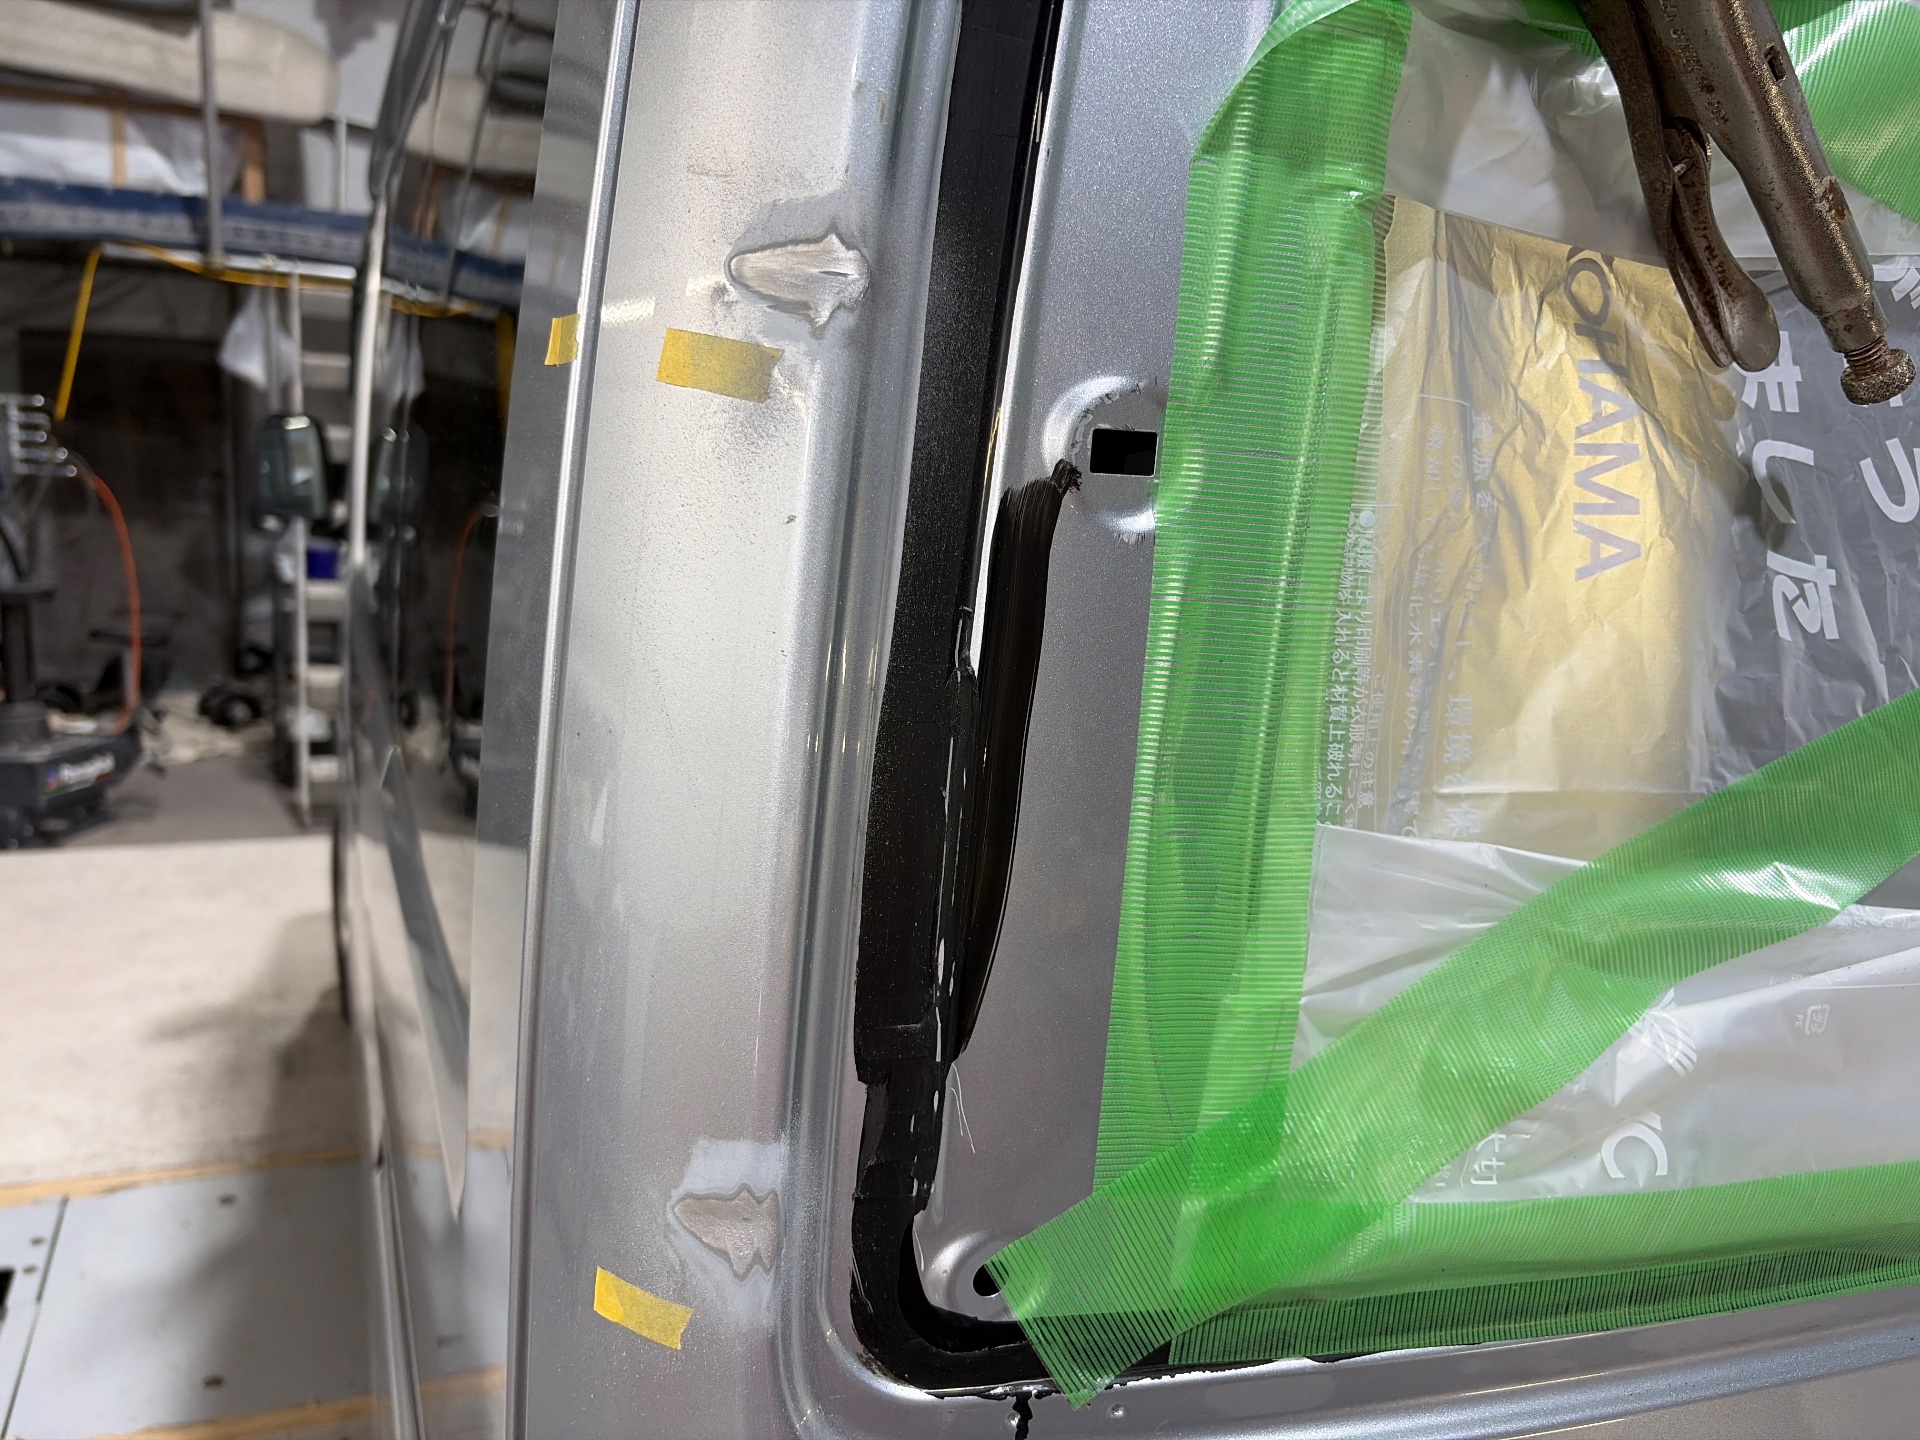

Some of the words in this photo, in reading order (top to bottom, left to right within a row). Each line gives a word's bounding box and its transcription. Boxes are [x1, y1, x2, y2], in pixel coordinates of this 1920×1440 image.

[1732, 330, 1840, 642] ました
[1358, 674, 1385, 809] ご使用上の注意
